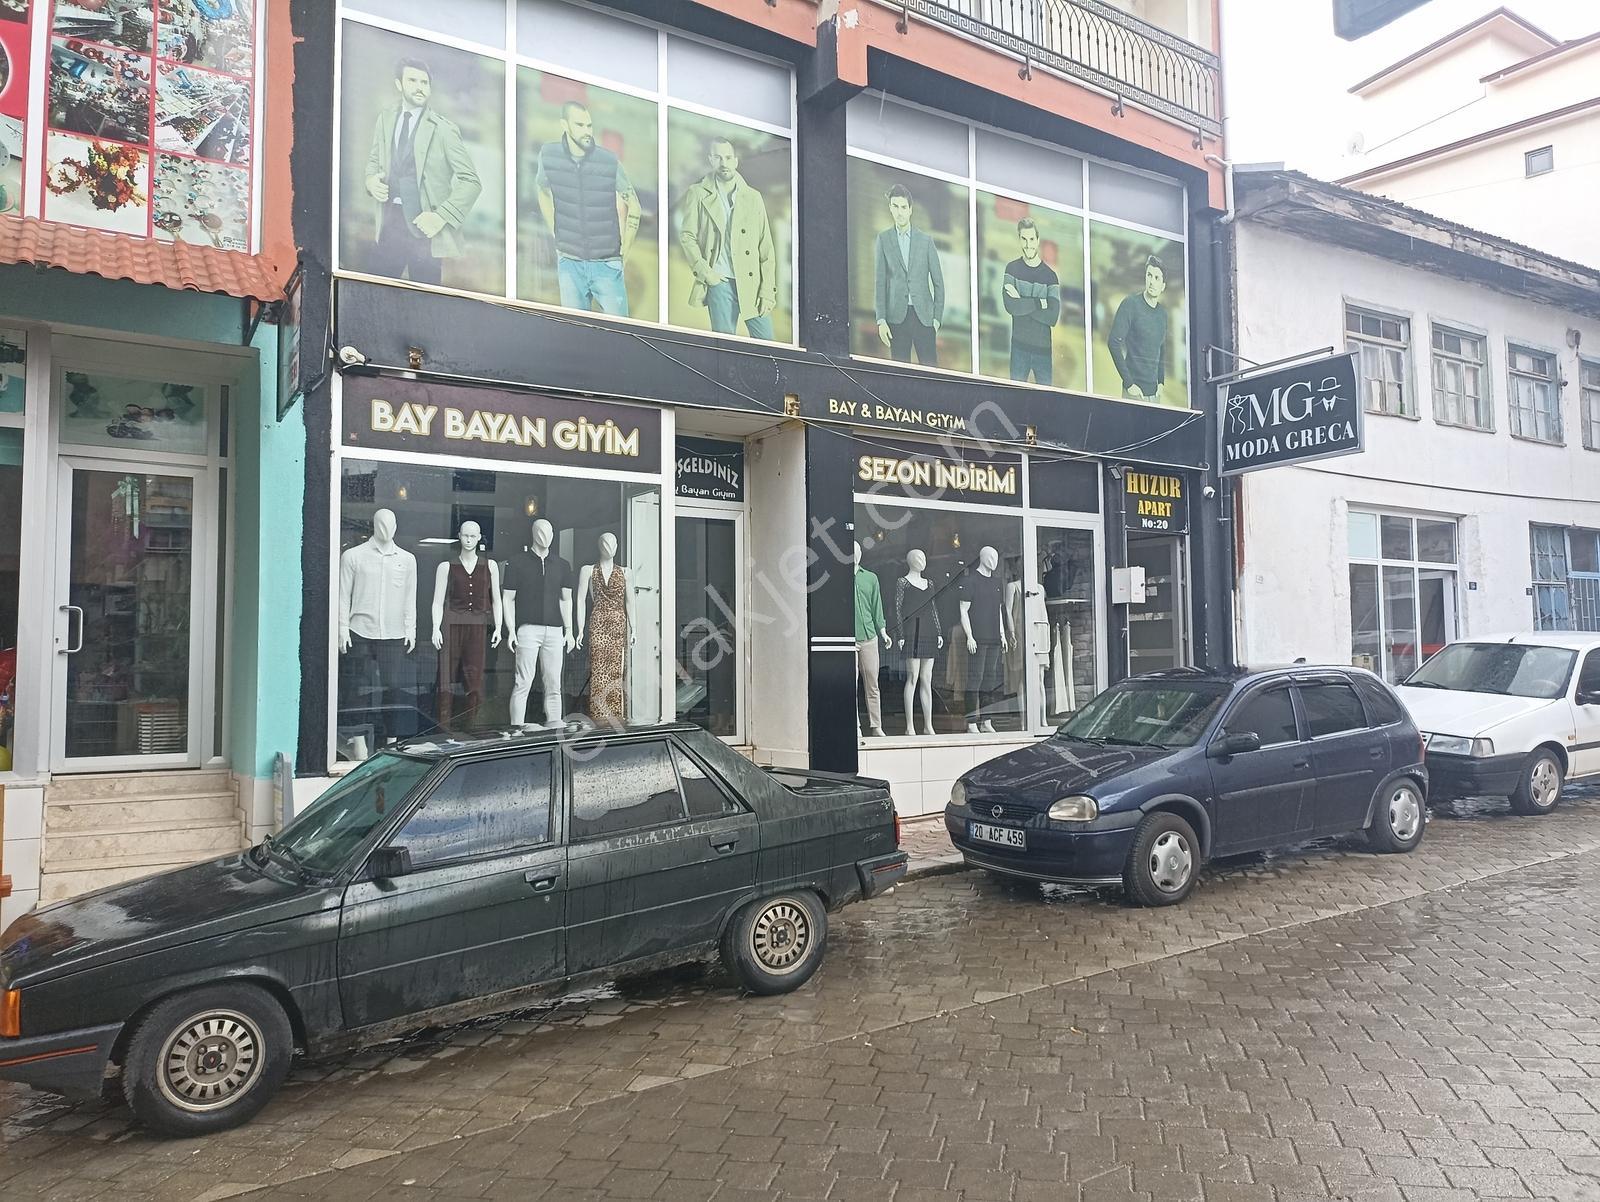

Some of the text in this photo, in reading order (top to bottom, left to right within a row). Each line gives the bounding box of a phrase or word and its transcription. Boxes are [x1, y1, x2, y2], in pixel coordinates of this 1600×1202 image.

[829, 399, 857, 416] BAY
[861, 404, 872, 418] &
[875, 405, 922, 424] BAYAN
[1247, 381, 1313, 431] MG
[371, 399, 640, 456] BAY BAYAN GİYİM
[1226, 421, 1355, 462] MODA GRECA
[675, 457, 739, 489] ŞGELDİNİZ
[858, 455, 1016, 495] SEZON İNDİRİMİ
[1126, 472, 1181, 498] HUZUR
[681, 485, 710, 496] Bayan
[712, 488, 736, 499] Giyim
[1137, 500, 1172, 517] APART
[1141, 518, 1169, 530] No:20
[975, 825, 1023, 845] 20 ACF 459
